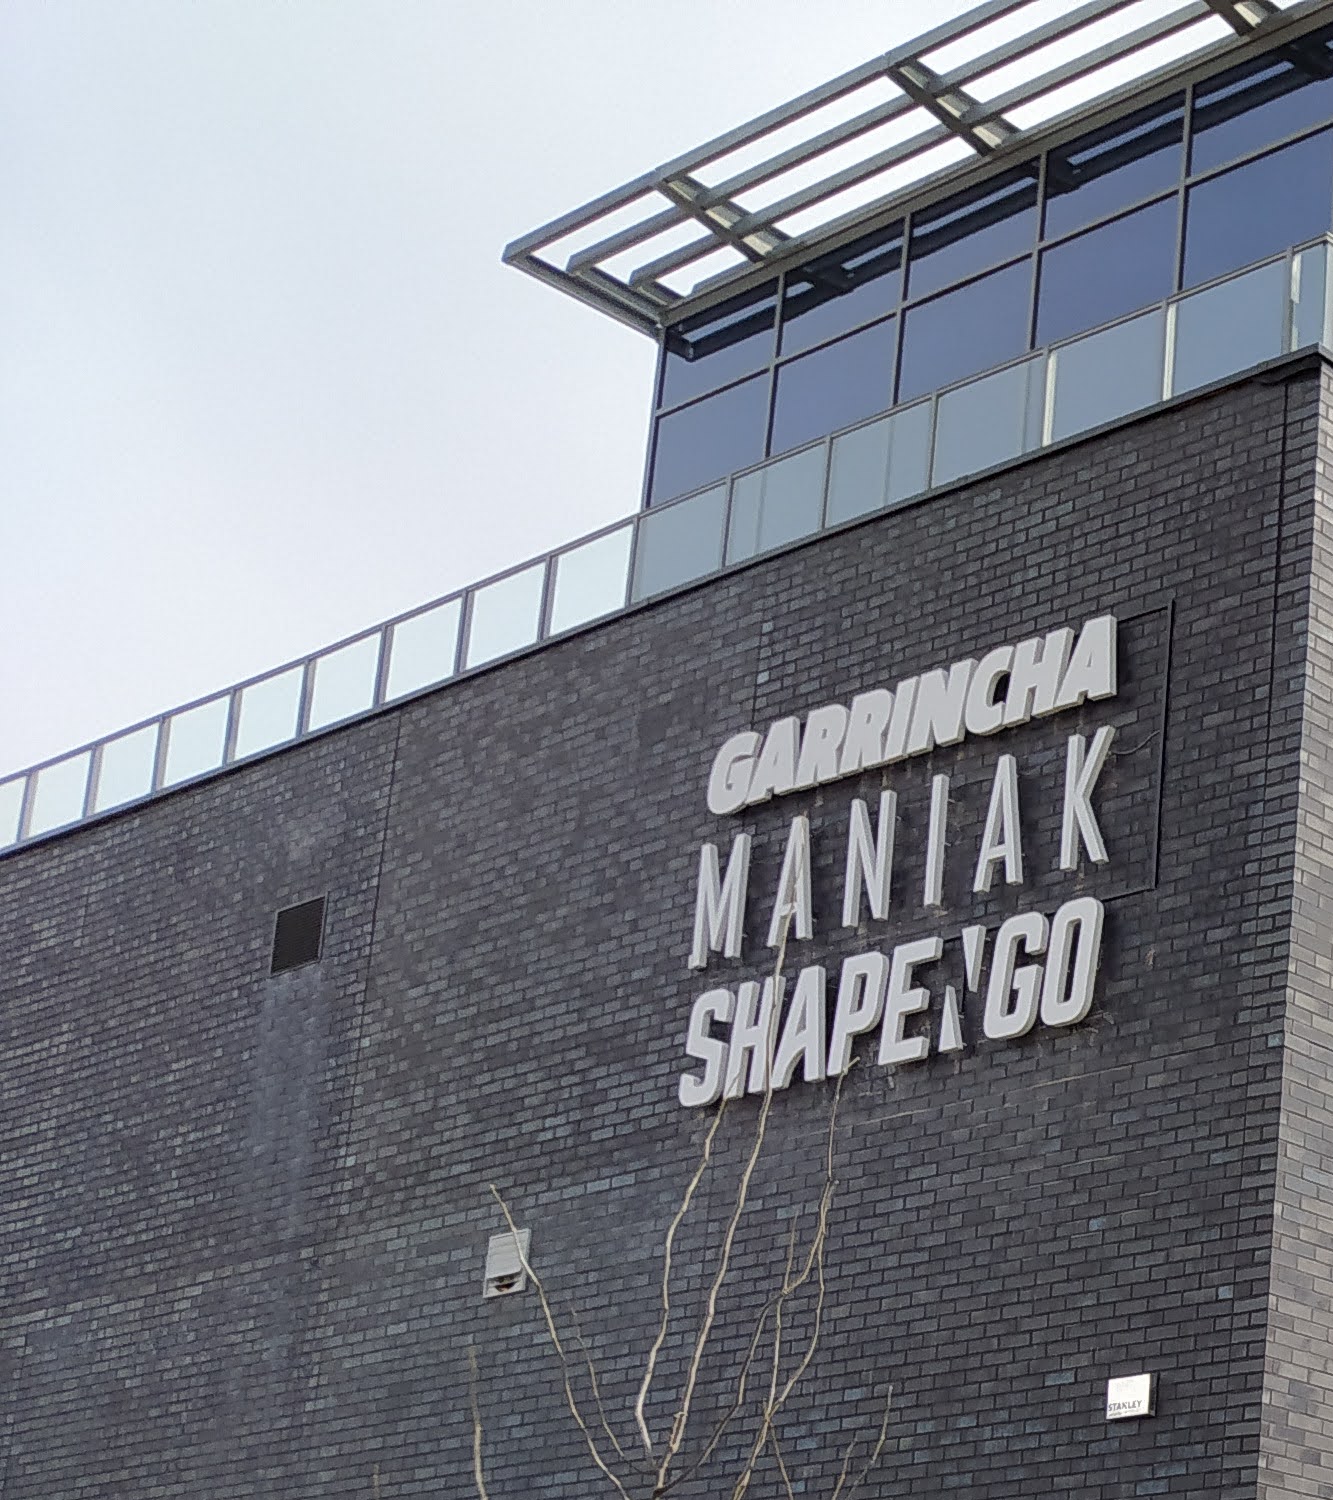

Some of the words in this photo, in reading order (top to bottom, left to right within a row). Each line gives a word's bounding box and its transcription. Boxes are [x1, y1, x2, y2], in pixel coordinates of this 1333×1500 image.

[707, 614, 1117, 815] GARRINCHA
[688, 725, 1116, 969] MANIAK
[1108, 1399, 1142, 1412] STANLEY
